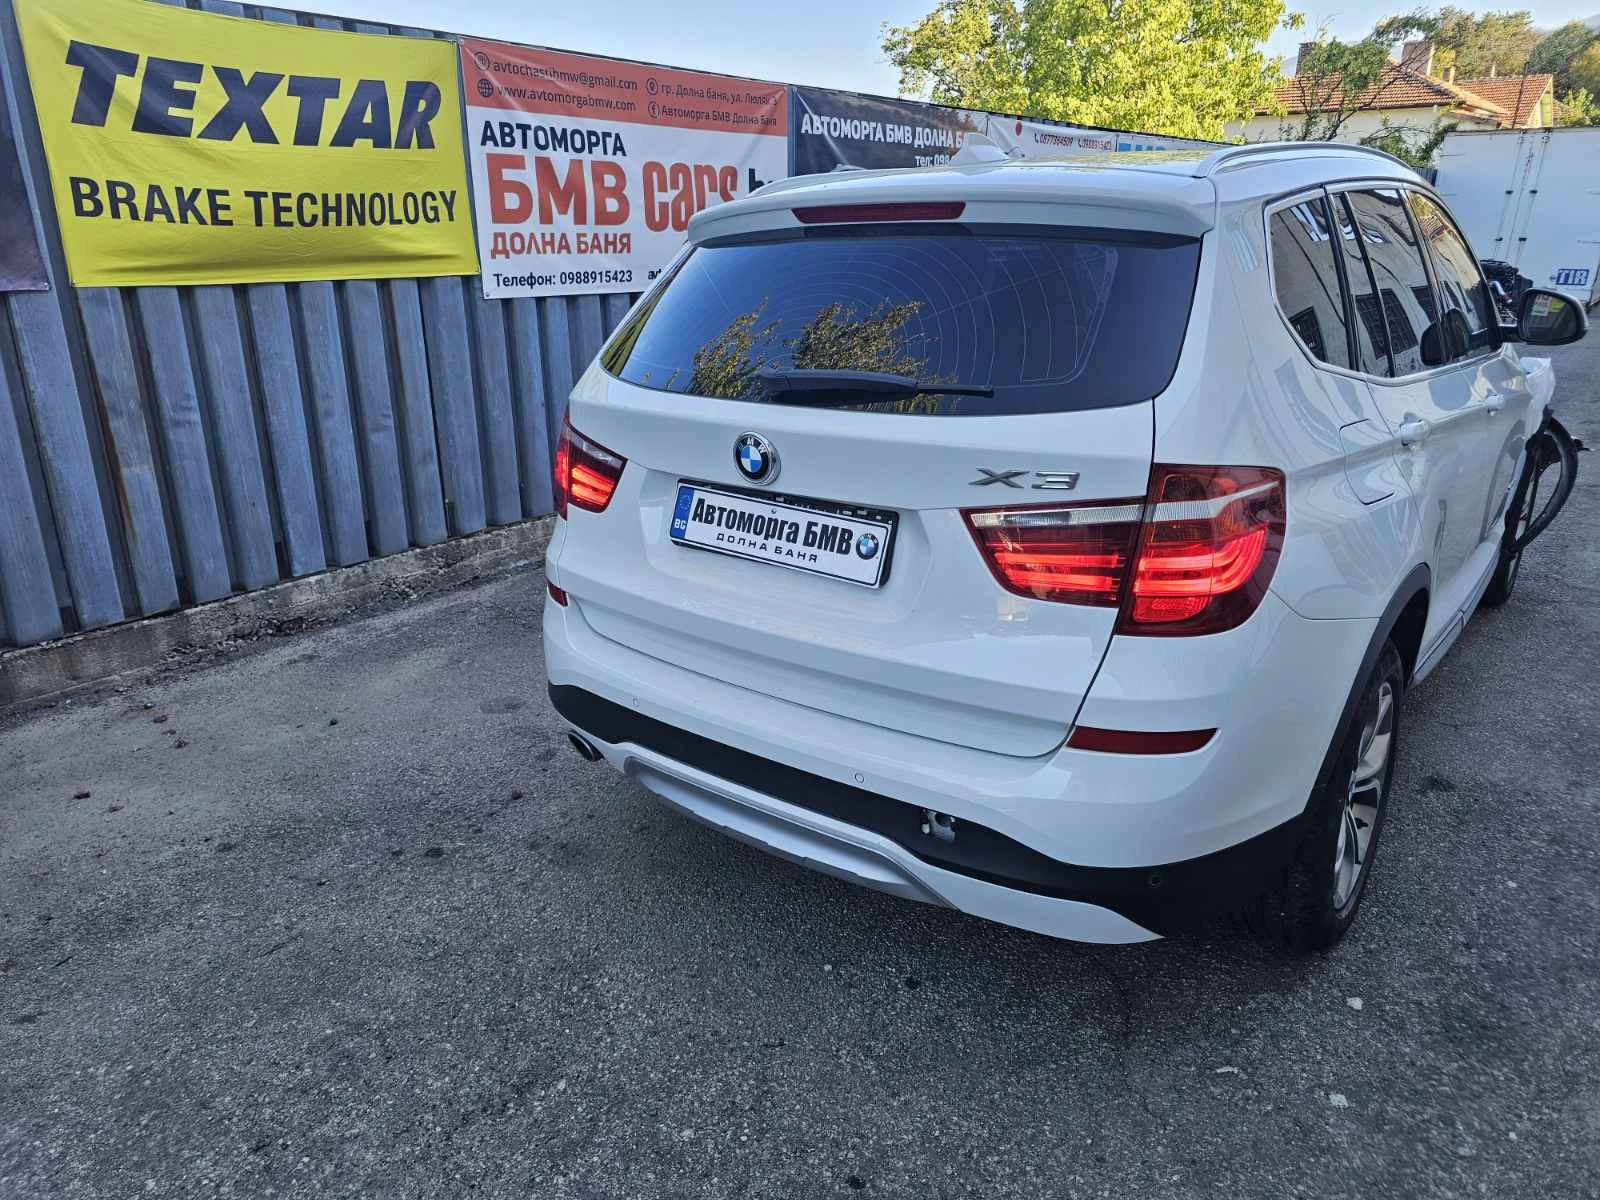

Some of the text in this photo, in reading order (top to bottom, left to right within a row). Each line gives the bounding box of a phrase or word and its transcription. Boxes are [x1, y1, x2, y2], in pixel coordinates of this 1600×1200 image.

[65, 40, 442, 150] TEXTAR
[496, 85, 636, 112] www.avtomorgabmw.com
[676, 84, 704, 99] Долна
[662, 105, 710, 121] Автоморга
[712, 110, 731, 122] БМВ
[733, 112, 759, 126] Долна
[480, 120, 627, 156] АВТОМОРГА
[801, 113, 884, 142] АВТОМОРГА
[886, 124, 912, 144] БМВ
[914, 127, 953, 148] ДОЛНА
[69, 176, 457, 228] BRAKE TECHNOLOGY
[486, 153, 630, 226] БМВ
[490, 232, 632, 259] ДОЛНА БАНЯ
[493, 270, 633, 289] Телефон: 0988915423
[1557, 270, 1588, 285] TIR
[967, 467, 1080, 490] X3
[674, 519, 686, 530] BG
[691, 497, 800, 545] Автоморга
[802, 520, 854, 556] БМВ
[716, 533, 819, 563] ДОЛНА БАНЯ
